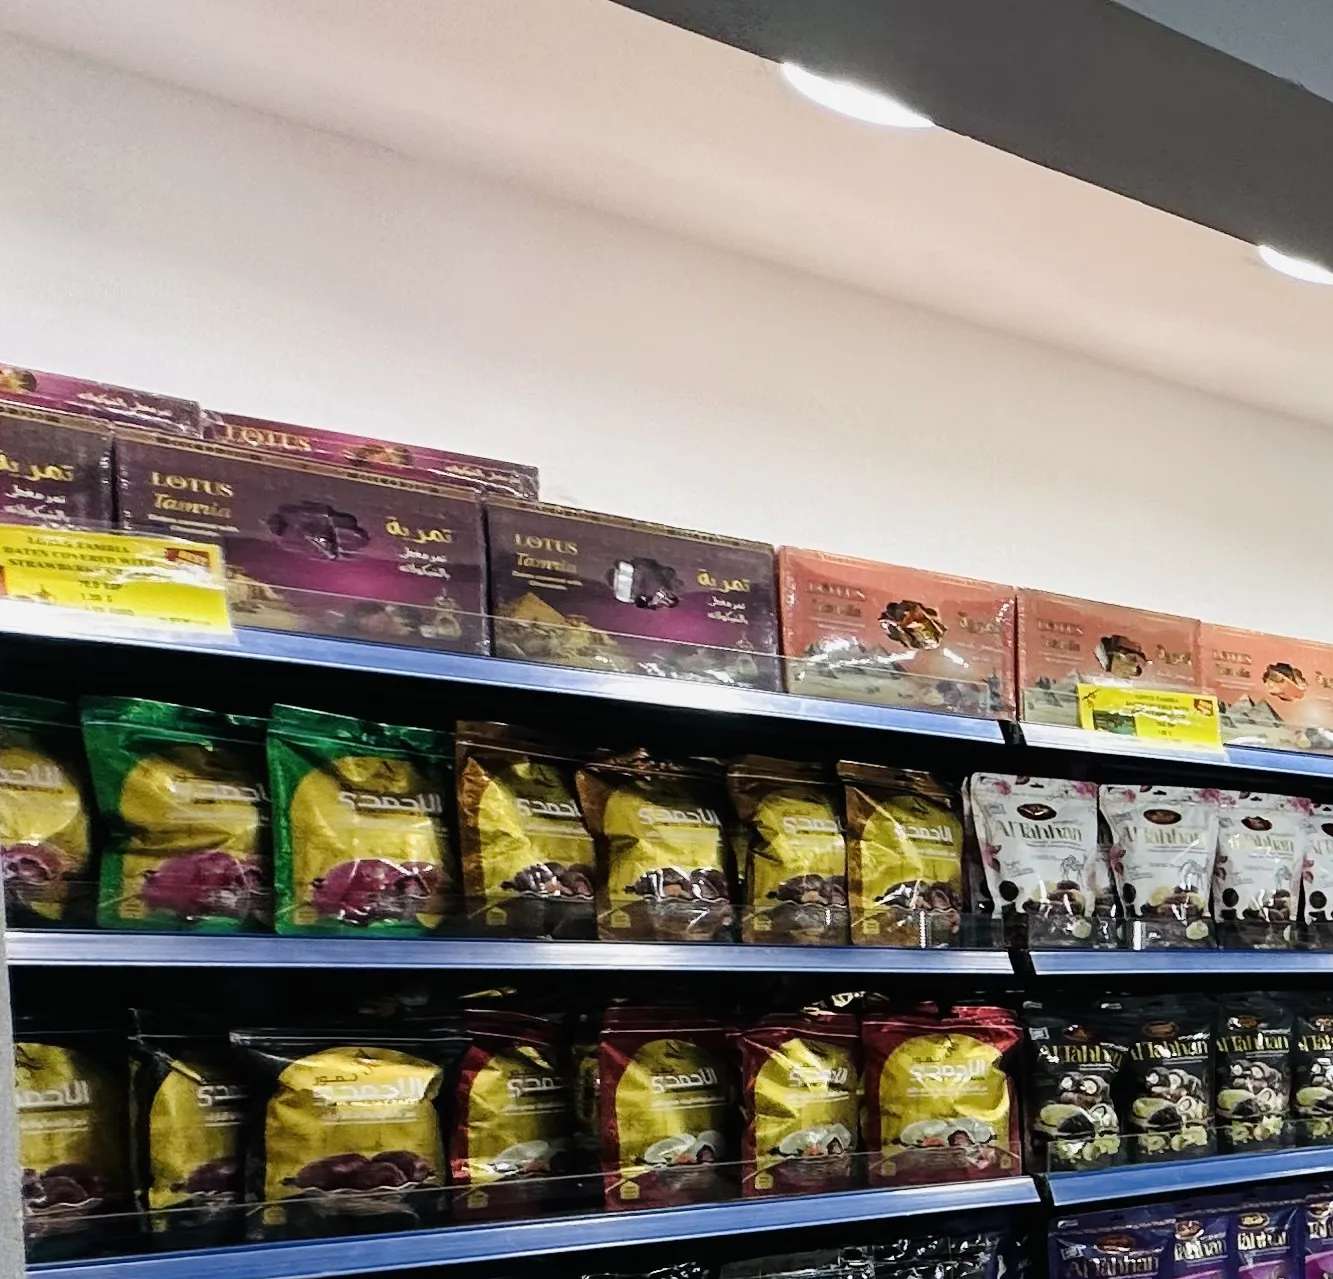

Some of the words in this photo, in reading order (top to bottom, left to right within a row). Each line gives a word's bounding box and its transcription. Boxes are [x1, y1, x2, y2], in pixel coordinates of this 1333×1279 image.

[221, 424, 312, 453] LOTUS
[152, 471, 235, 498] LOTUS
[513, 533, 578, 556] LOTUS
